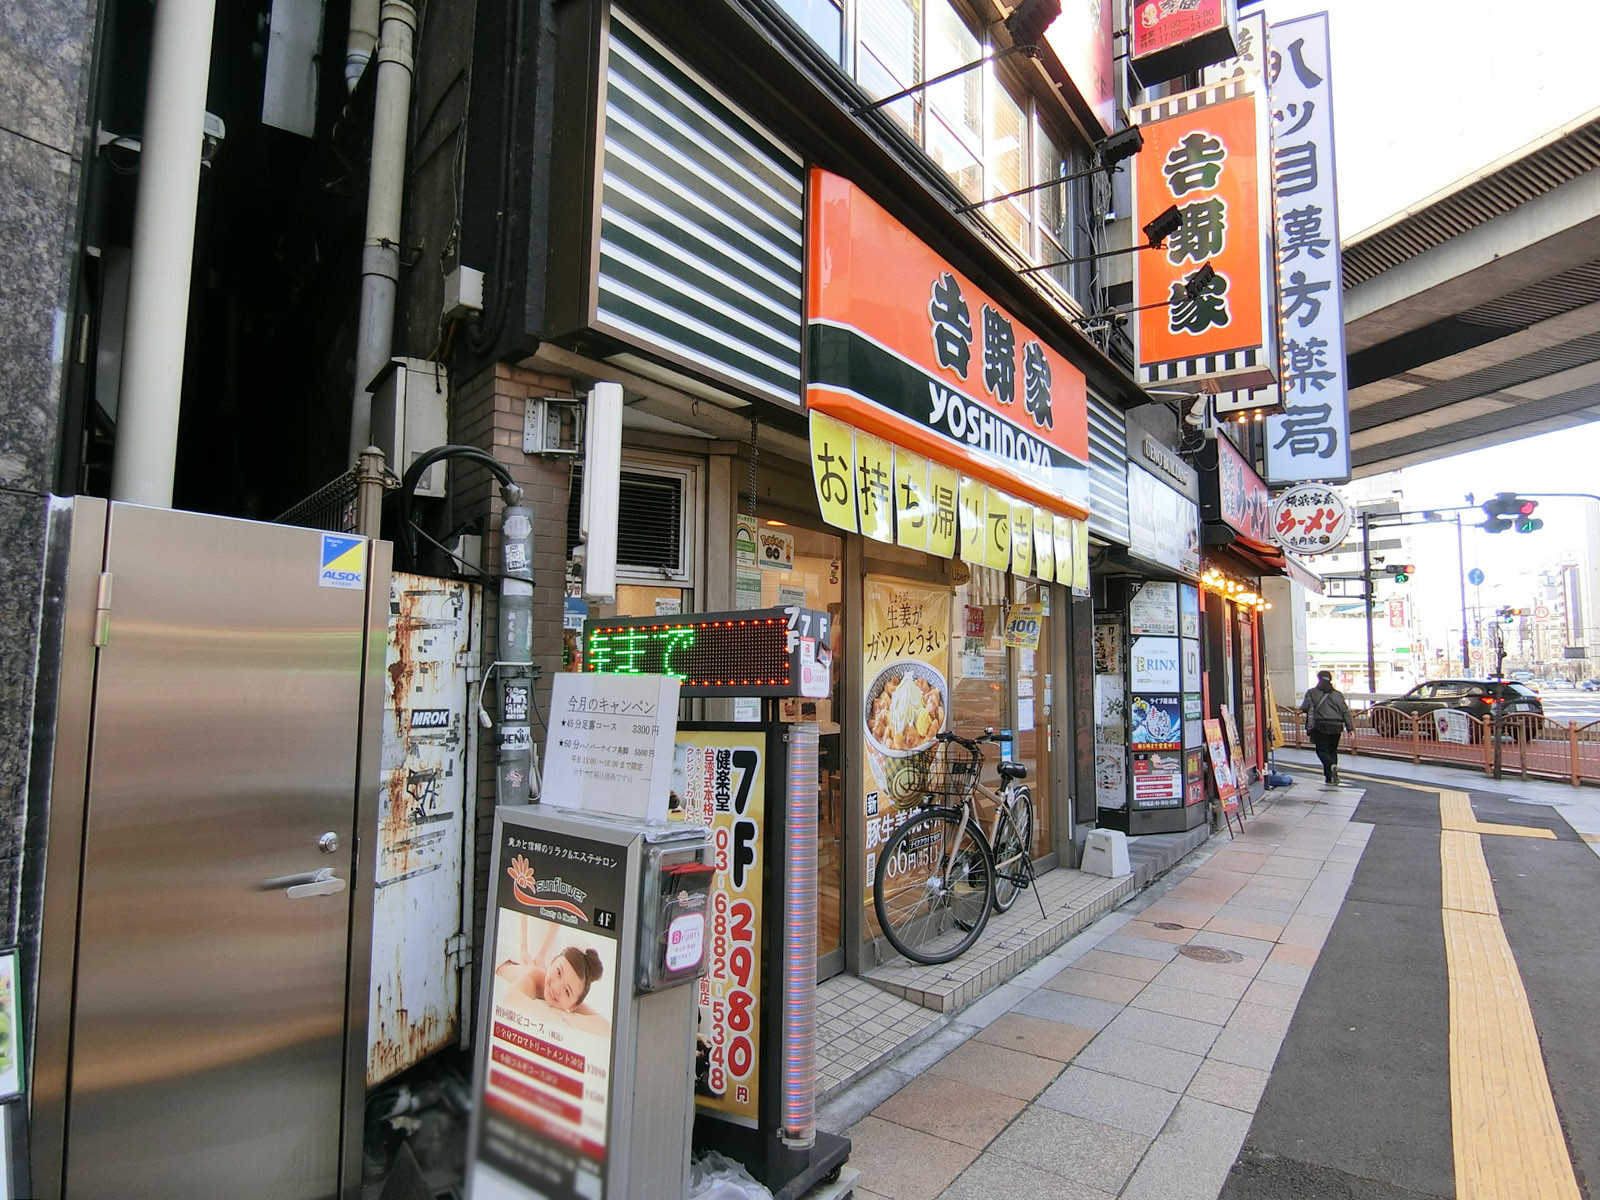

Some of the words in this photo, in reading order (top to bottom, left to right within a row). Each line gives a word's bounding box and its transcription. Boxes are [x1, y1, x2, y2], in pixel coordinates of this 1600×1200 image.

[1162, 130, 1231, 335] 吉野家
[928, 271, 1053, 432] 吉野家
[928, 381, 1053, 477] YOSHINOYA
[1276, 508, 1346, 536] ラーメン
[322, 571, 361, 582] ALSOK
[886, 603, 923, 631] 生姜が
[867, 626, 947, 664] ガツンとうまい
[412, 711, 449, 727] MROK
[568, 695, 656, 715] 今月のキャンペン
[632, 724, 660, 737] 3300円
[716, 749, 731, 812] 健楽堂
[867, 794, 877, 814] 新
[732, 750, 757, 888] 7F
[536, 876, 588, 904] sunflower
[598, 912, 612, 927] 4F
[495, 1005, 545, 1035] 初回限定コース
